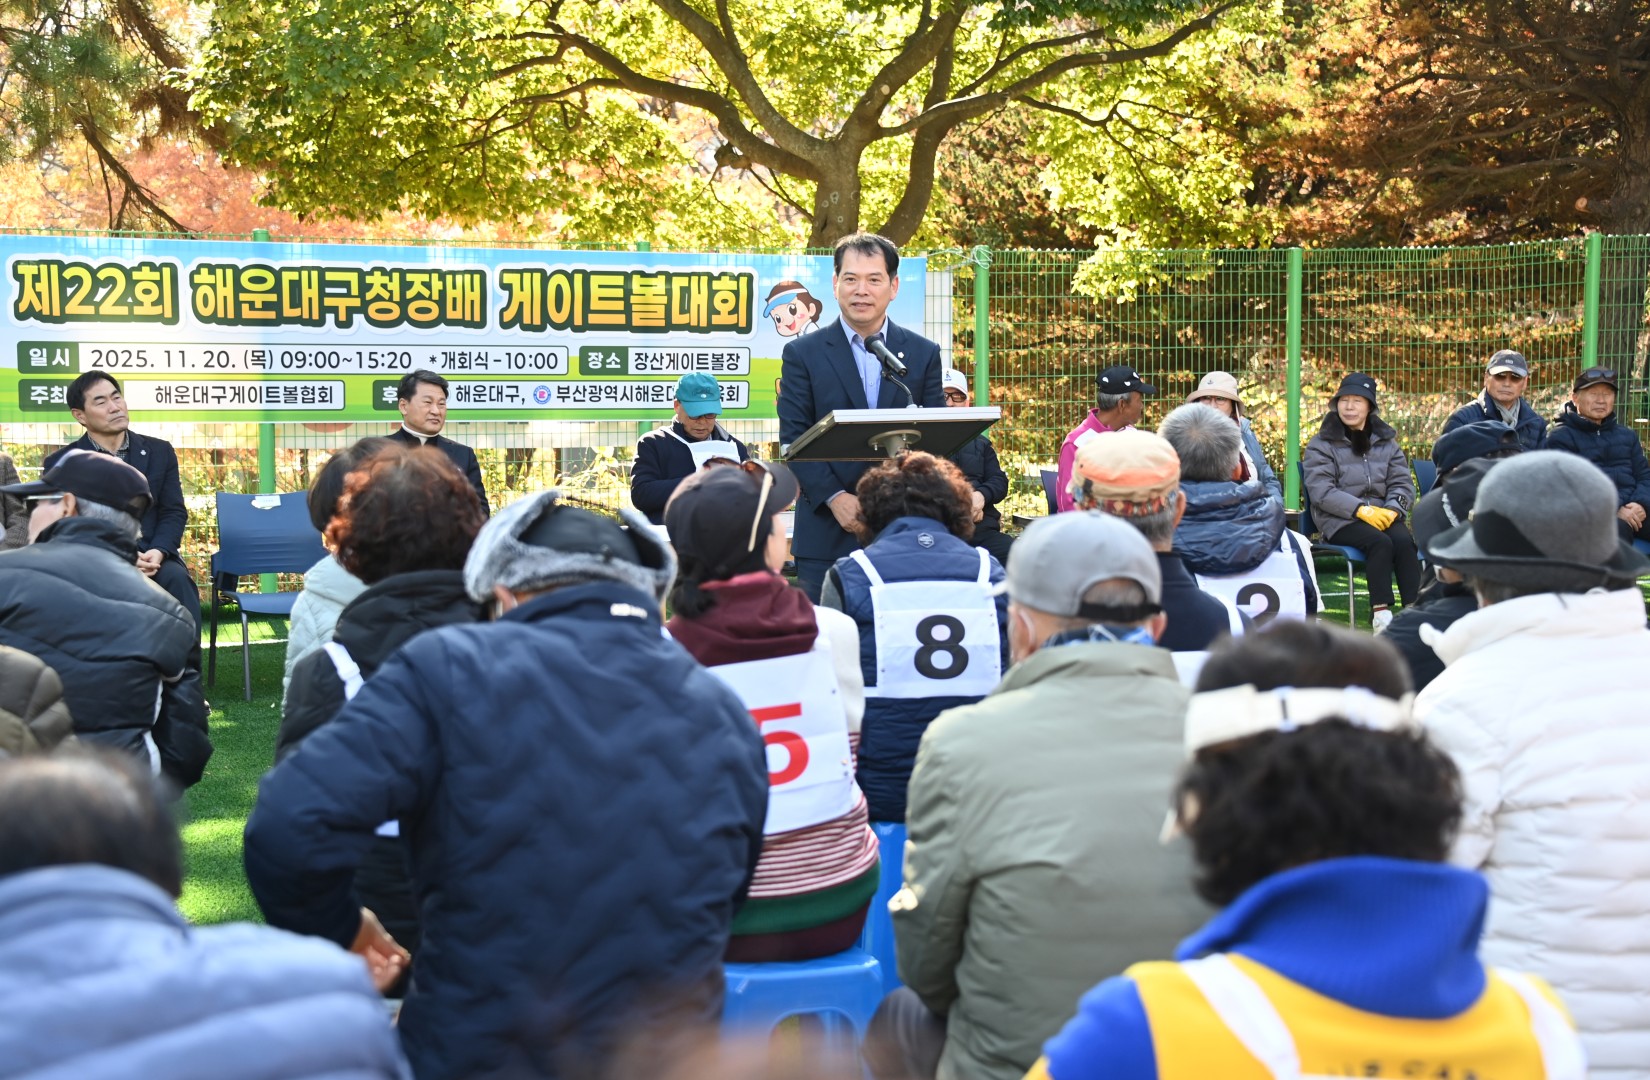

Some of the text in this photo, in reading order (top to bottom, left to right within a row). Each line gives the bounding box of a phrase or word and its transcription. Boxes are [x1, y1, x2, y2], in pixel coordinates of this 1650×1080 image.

[17, 264, 748, 328] 제22회 해운대구청장배 게이트볼대회
[29, 348, 70, 367] 일시
[91, 349, 155, 368] 2025.
[164, 350, 196, 368] 11.
[203, 350, 236, 369] 20.
[244, 349, 274, 370] (목)
[280, 351, 412, 370] 09:00~15:20
[587, 352, 621, 370] 장소
[634, 352, 740, 371] 장산게이트볼장
[30, 386, 68, 404] 주최
[155, 385, 333, 404] 해운대구게이트볼협회
[455, 385, 525, 405] 해운대구,
[556, 385, 740, 403] 부산광역시해운회
[914, 614, 969, 680] 8
[748, 702, 810, 786] 5
